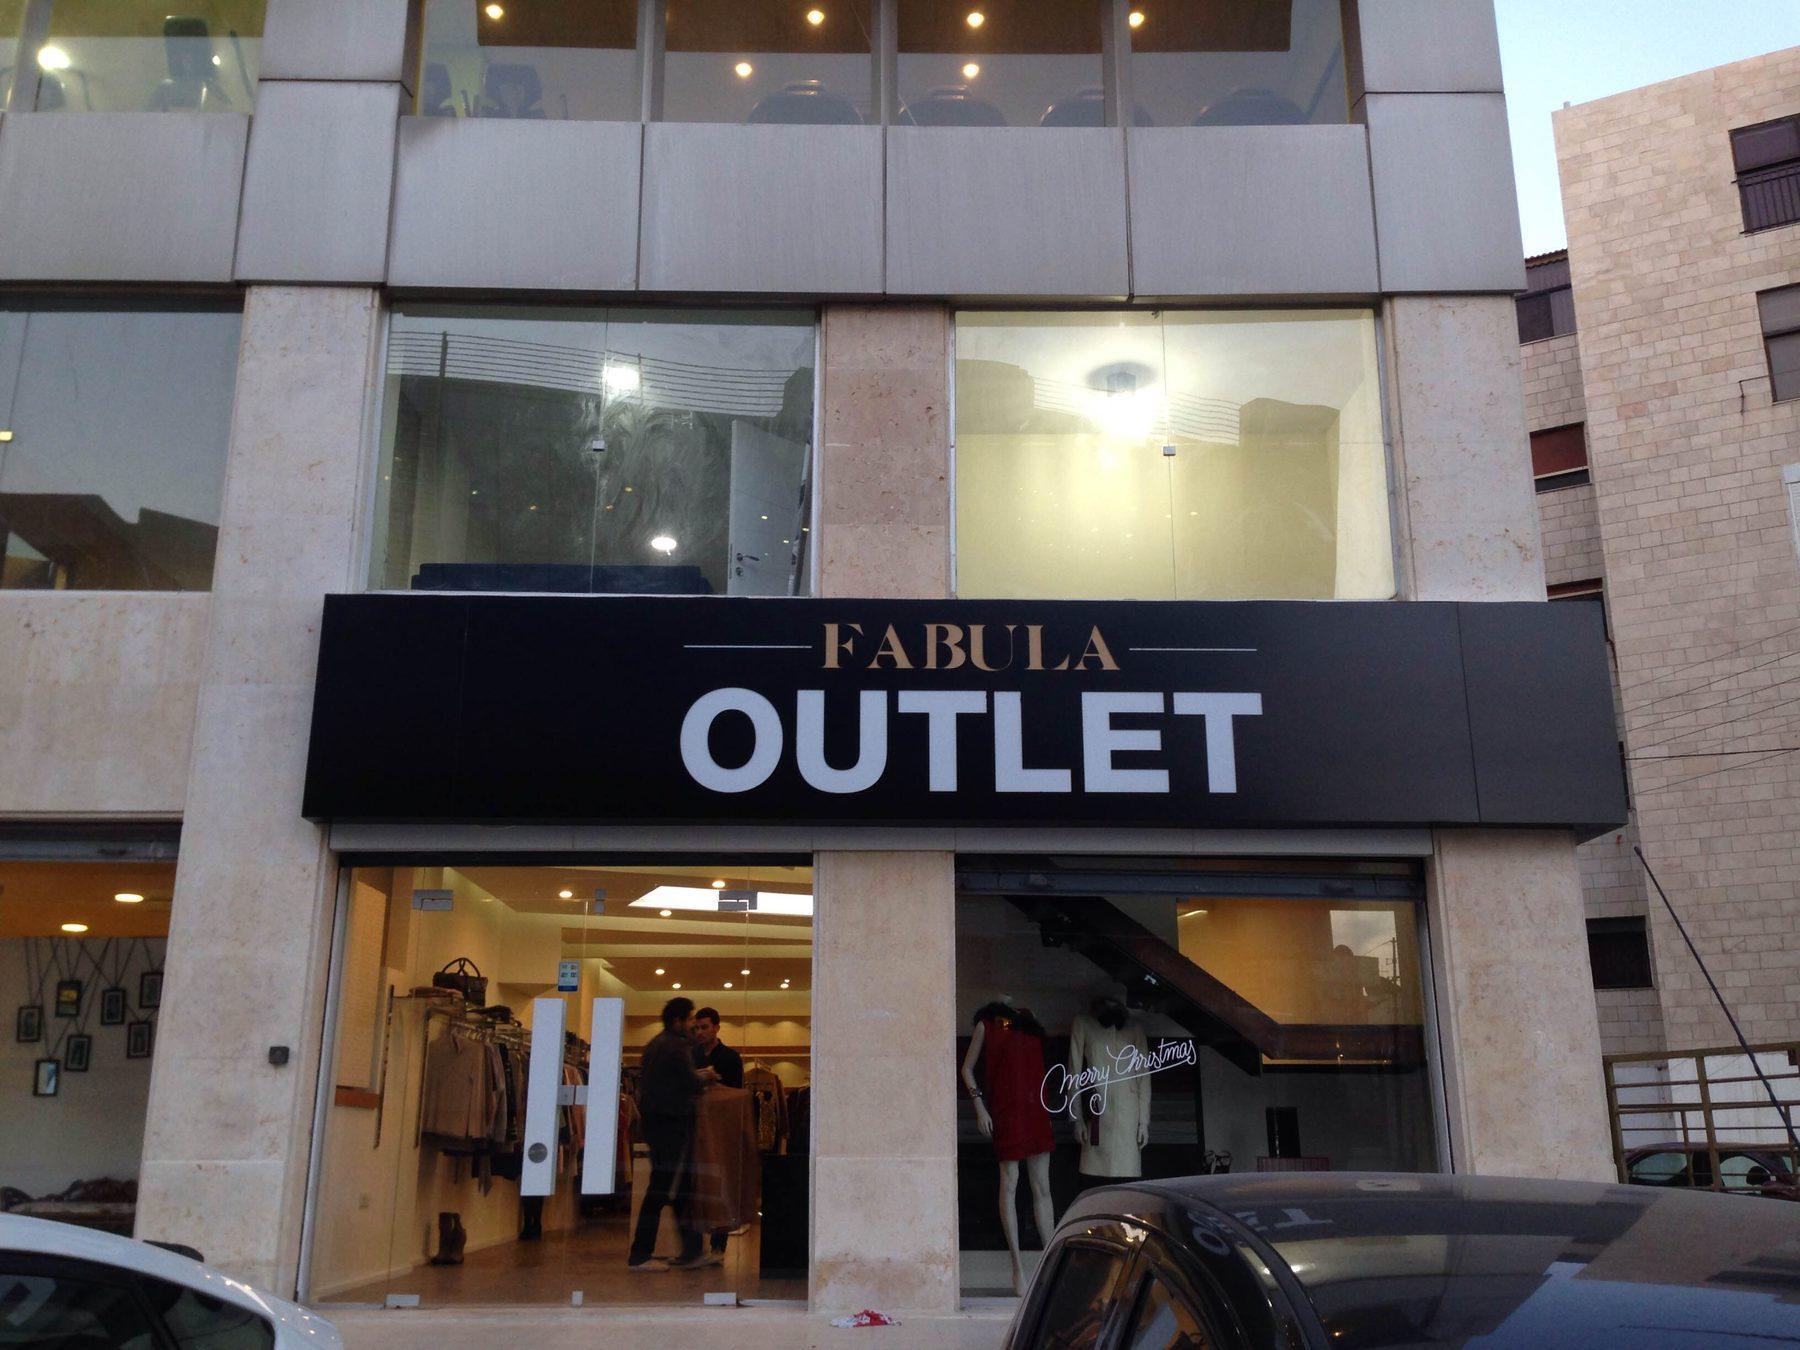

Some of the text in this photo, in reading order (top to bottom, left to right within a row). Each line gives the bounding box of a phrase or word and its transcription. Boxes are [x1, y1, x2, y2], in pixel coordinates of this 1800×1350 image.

[821, 623, 1120, 671] FABULA
[680, 687, 1263, 793] OUTLET
[1107, 1038, 1197, 1075] Christmas
